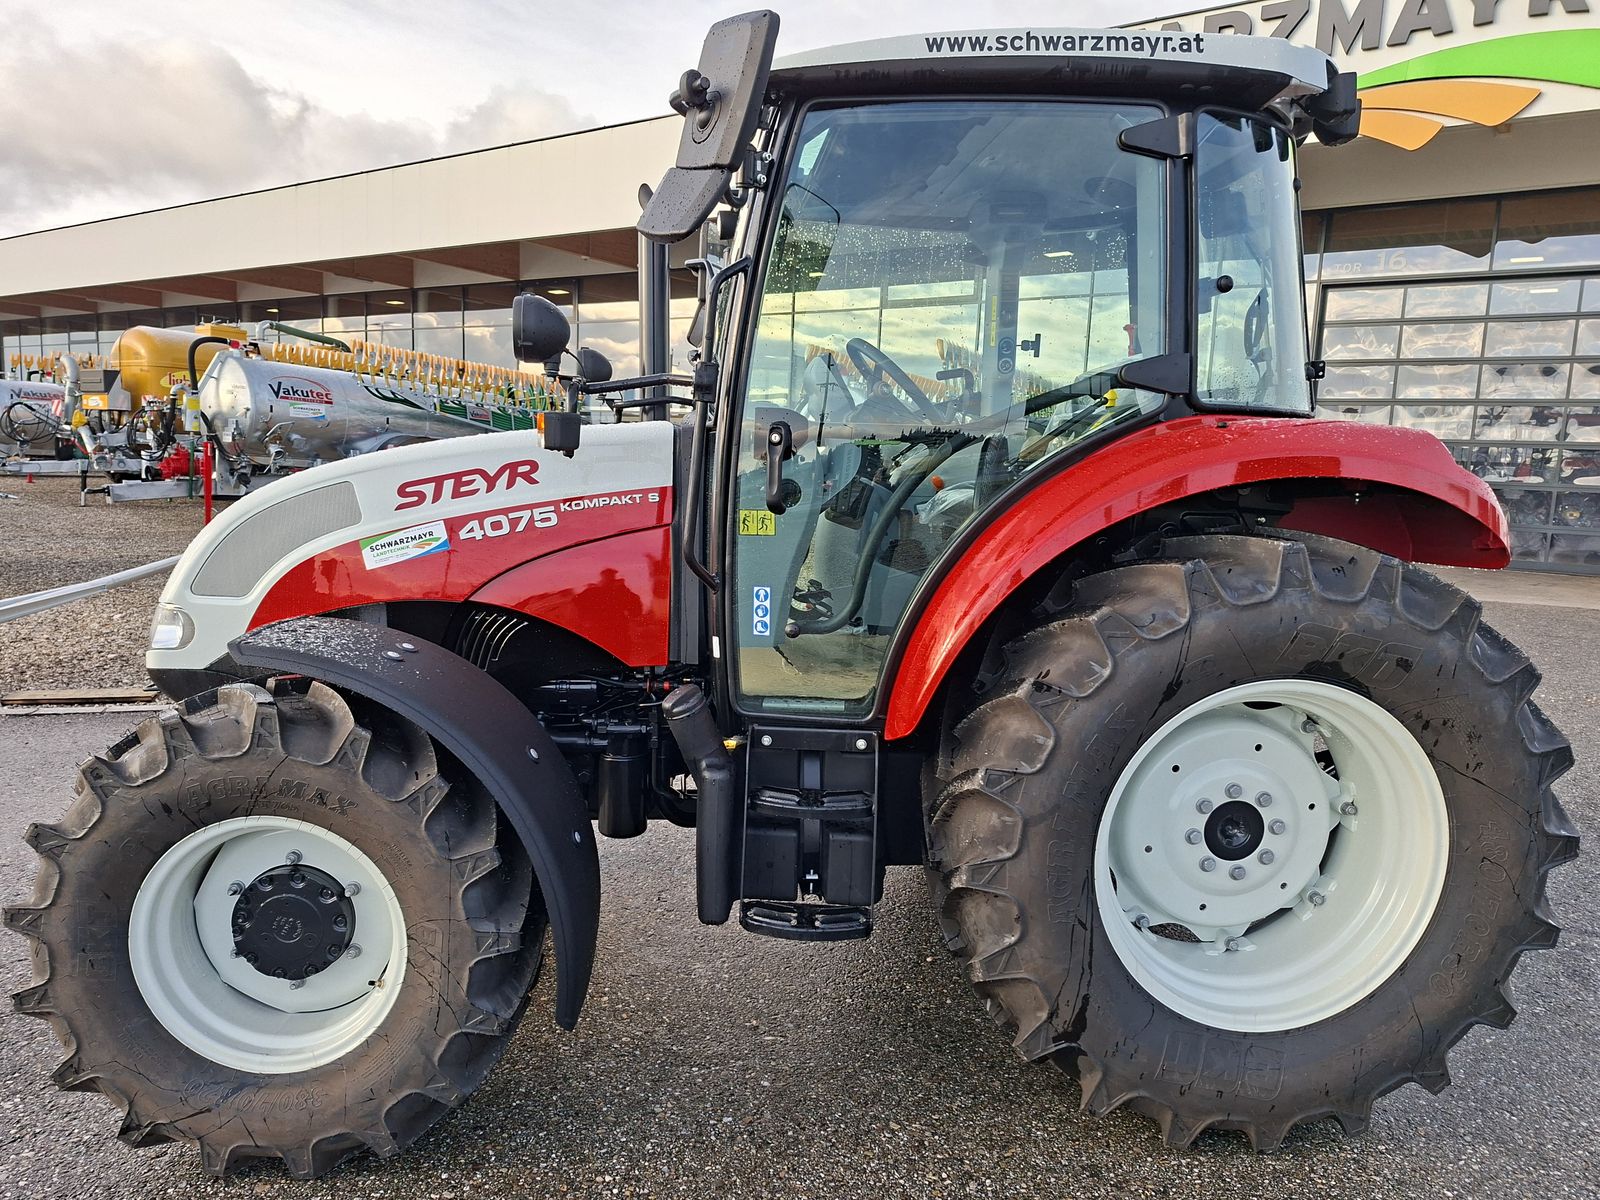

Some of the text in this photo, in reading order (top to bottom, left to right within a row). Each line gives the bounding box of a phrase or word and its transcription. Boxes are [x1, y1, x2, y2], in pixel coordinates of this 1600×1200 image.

[925, 31, 1205, 57] www.schwarzmayr.at
[1335, 249, 1408, 273] TOR 16
[268, 381, 333, 401] Vakutec
[394, 459, 541, 511] STEYR
[459, 506, 559, 541] 4075
[560, 494, 643, 513] KOMPAKT
[648, 492, 660, 503] S
[369, 530, 434, 553] SCHWARZMAYR
[373, 545, 411, 558] LANDTECHNIK
[185, 775, 358, 818] AGRI MAX
